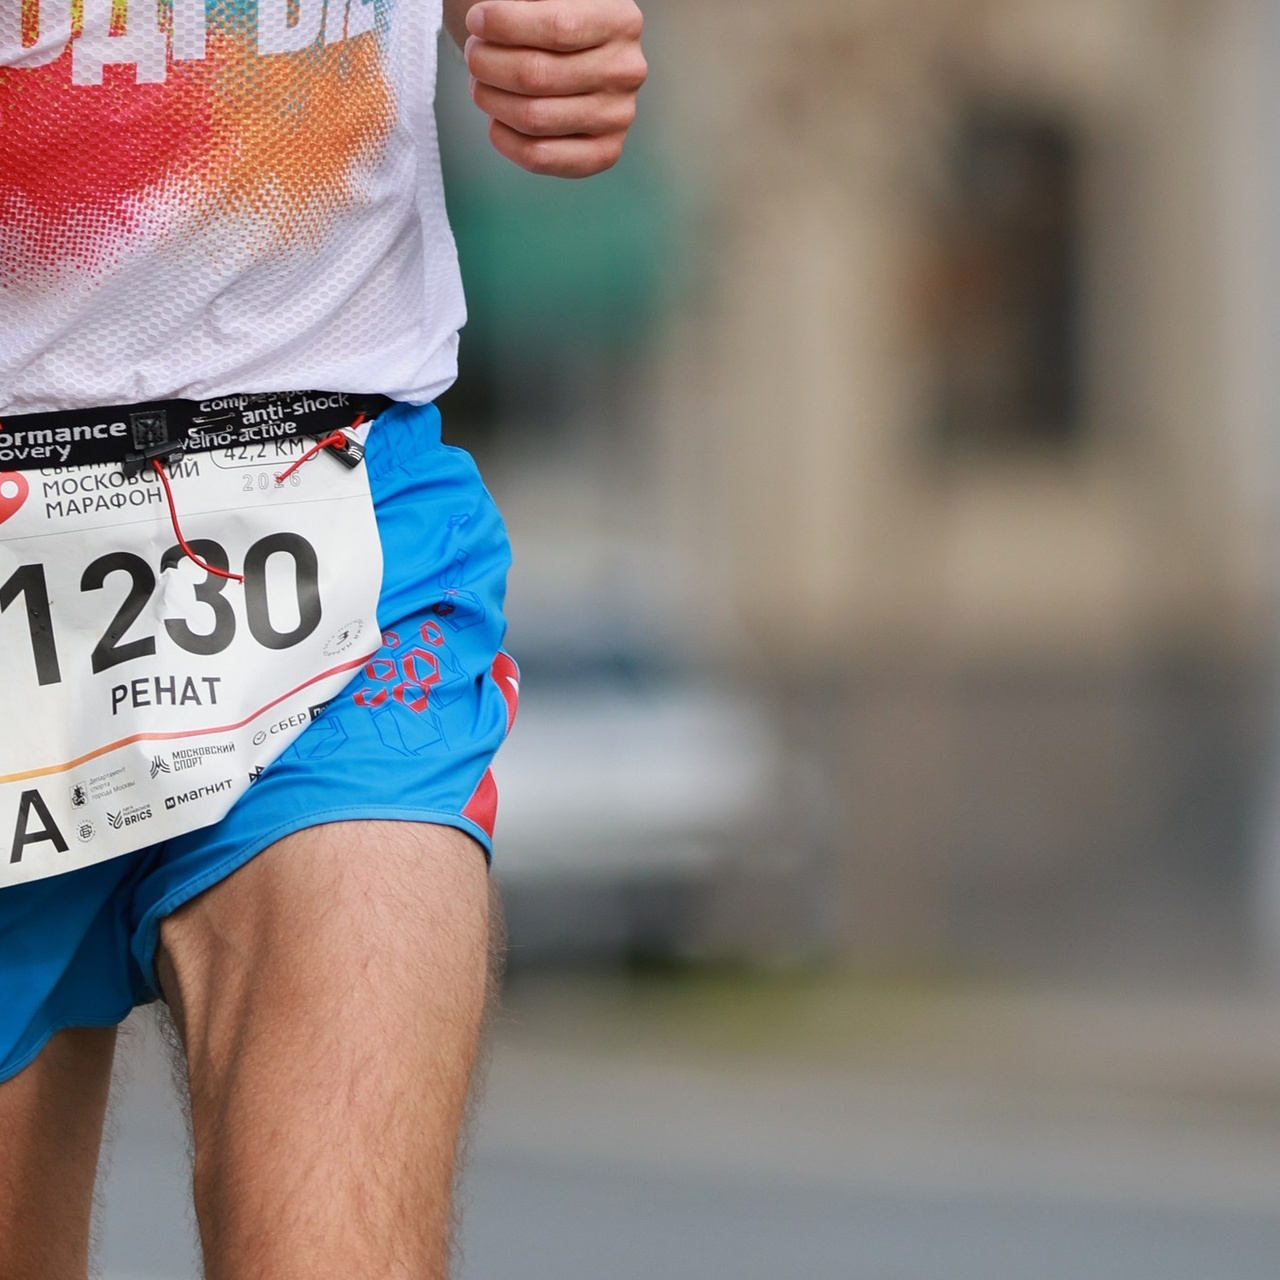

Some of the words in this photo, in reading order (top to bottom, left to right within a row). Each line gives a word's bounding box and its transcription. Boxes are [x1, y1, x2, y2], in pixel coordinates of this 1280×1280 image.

[241, 392, 350, 425] anti-shock
[44, 486, 163, 520] МАРАФОН
[110, 674, 222, 716] РЕНАТ
[269, 712, 308, 735] СБЕР
[171, 741, 236, 761] МОСКОВСКИЙ
[173, 756, 204, 772] СПОРТ
[9, 788, 70, 864] A
[124, 808, 153, 827] BRICS
